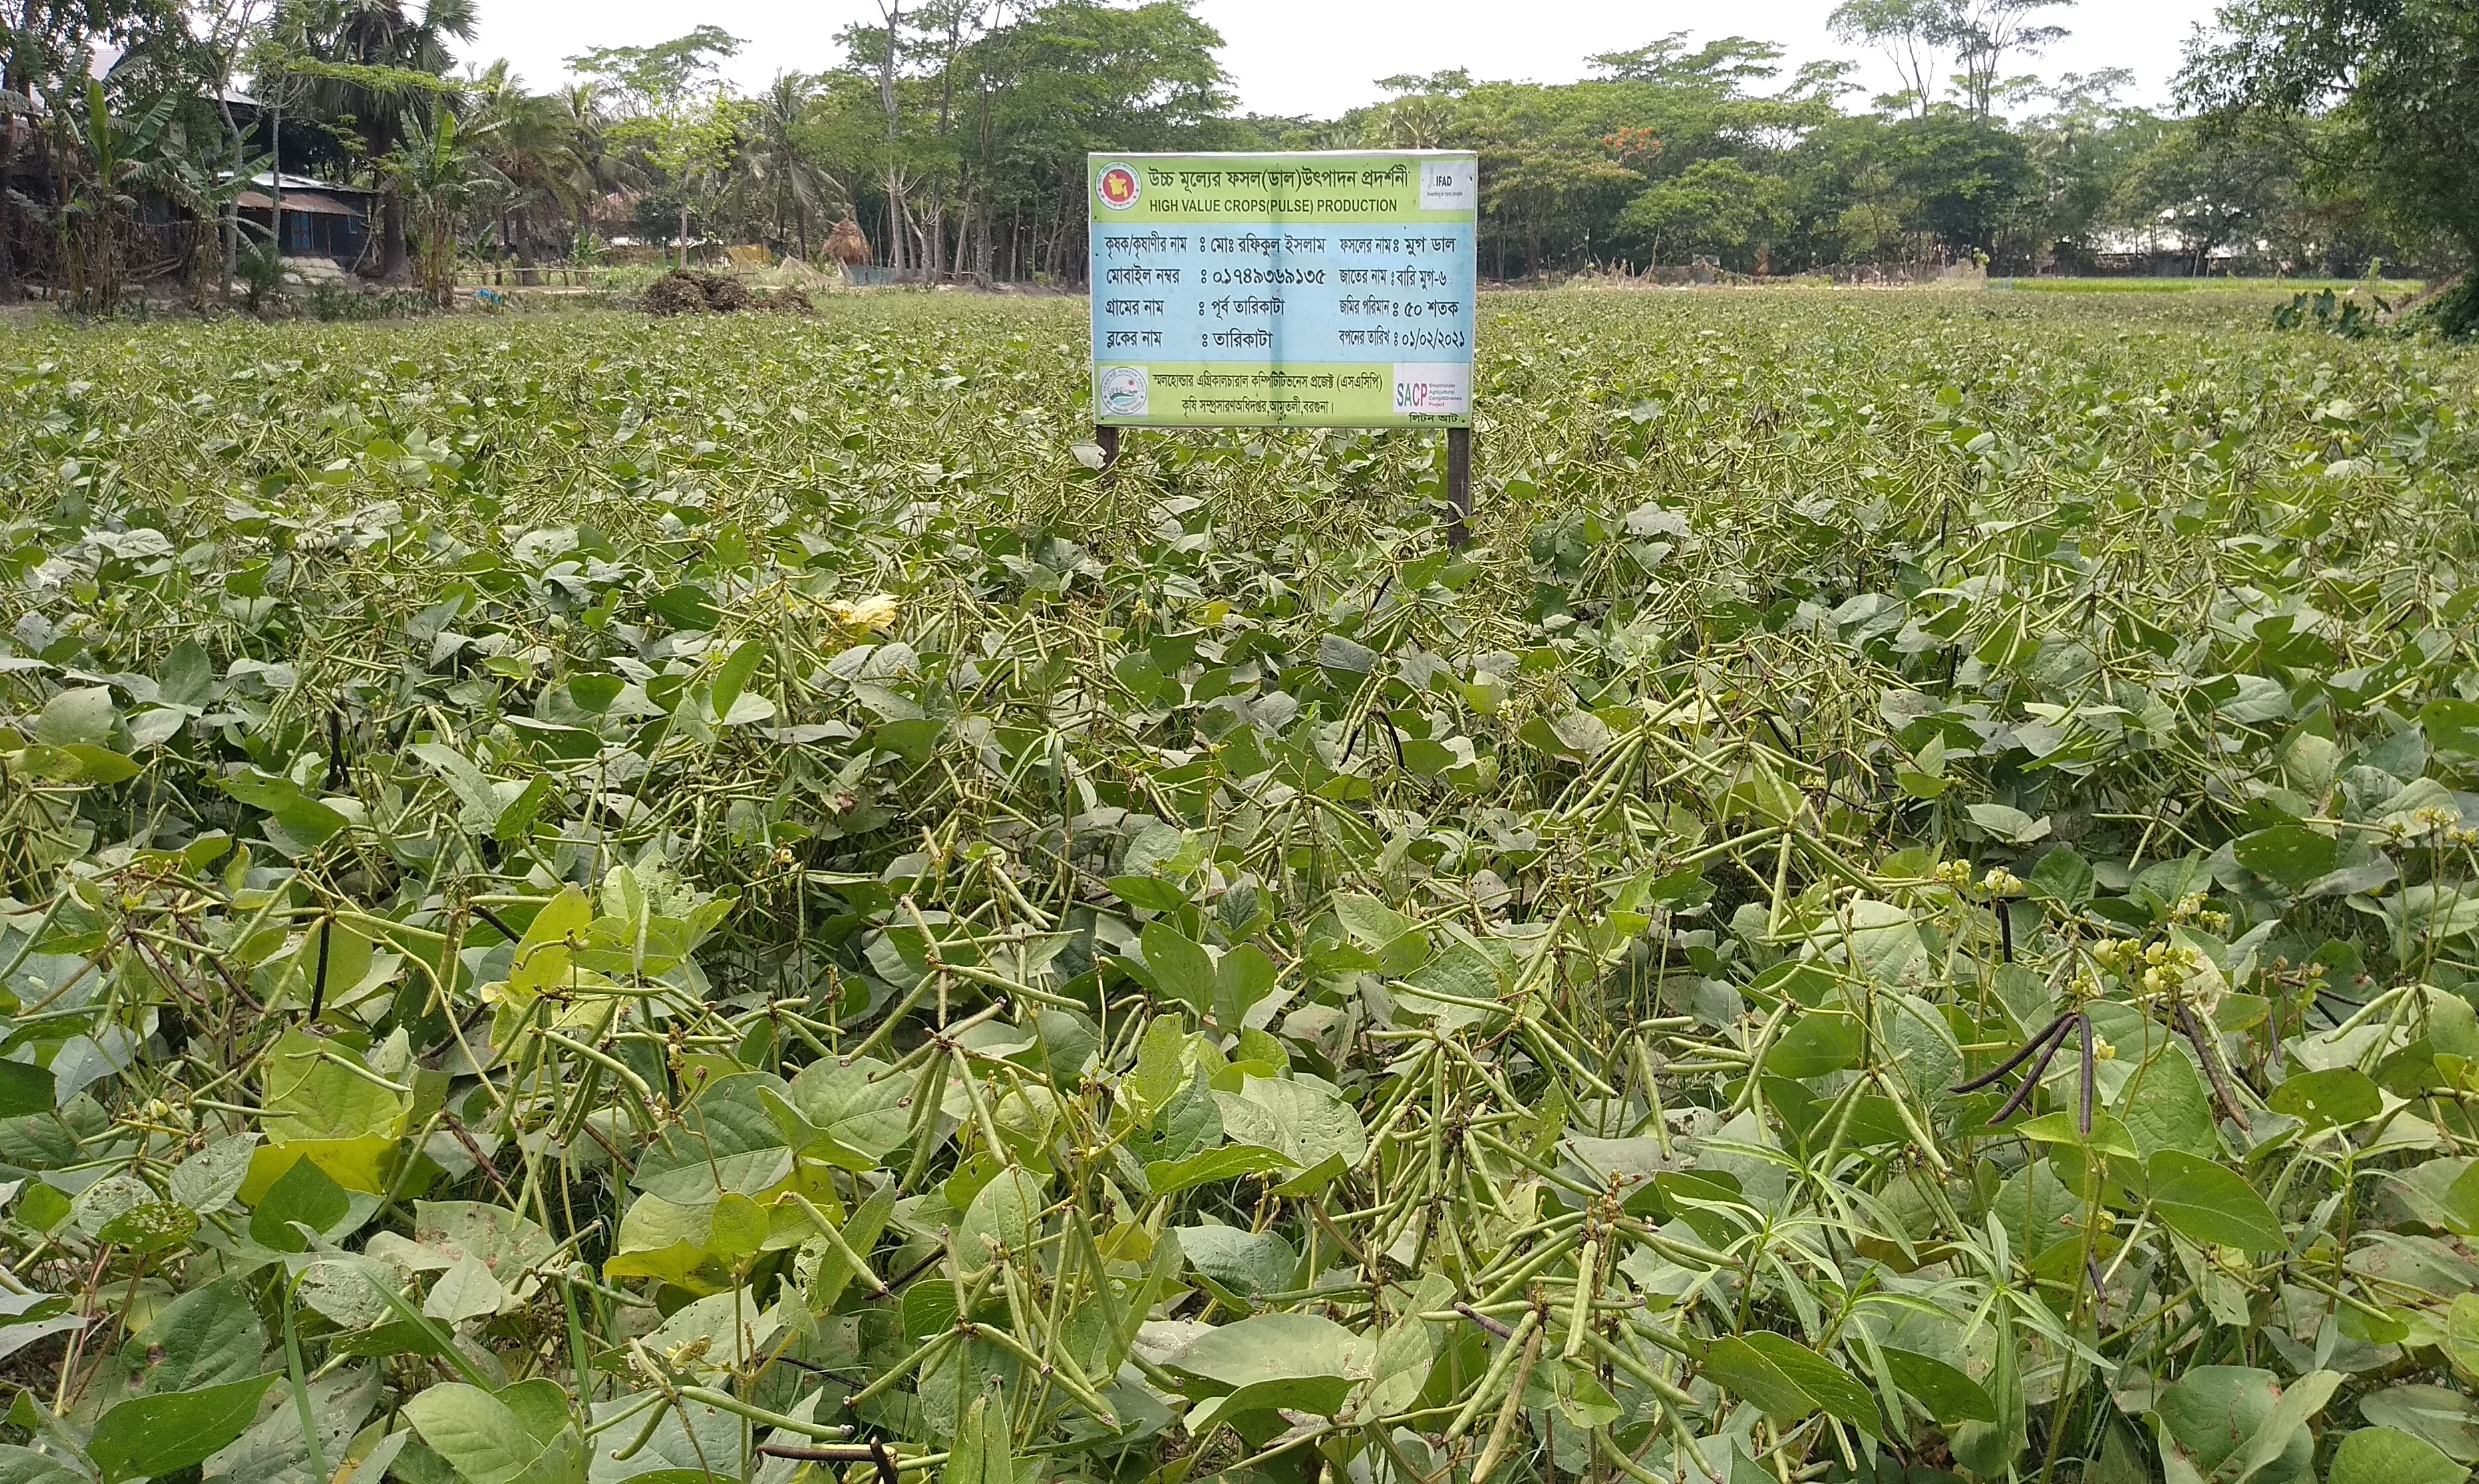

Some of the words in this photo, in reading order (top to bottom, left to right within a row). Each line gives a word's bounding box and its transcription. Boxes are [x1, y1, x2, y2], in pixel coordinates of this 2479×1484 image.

[1148, 166, 1175, 187] উচ্চ
[1178, 171, 1222, 194] মূল্যের
[1361, 164, 1408, 188] প্রদর্শনী
[1436, 176, 1452, 187] IFAD
[1150, 200, 1178, 212] HIGH
[1182, 200, 1220, 212] VALUE
[1224, 200, 1313, 215] CROPS(PULSE)
[1317, 200, 1397, 212] PRODUCTION
[1170, 235, 1187, 253] নাম
[1211, 236, 1234, 253] মোঃ
[1237, 233, 1281, 257] রফিকুল
[1284, 233, 1327, 255] ইসলাম
[1339, 238, 1373, 254] ফসলের
[1404, 237, 1426, 257] মুগ
[1430, 237, 1456, 253] ডাল
[1106, 263, 1152, 287] মোবাইল
[1155, 269, 1181, 285] নম্বর
[1213, 268, 1326, 285] ০১৭৪৯৩৬৯১৩৫
[1339, 267, 1369, 285] জাতের
[1371, 267, 1387, 285] নাম
[1396, 265, 1416, 287] বারি
[1418, 269, 1446, 291] মুগ-৬
[1106, 298, 1140, 317] গ্রামের
[1142, 298, 1165, 317] নাম
[1211, 295, 1231, 320] পূর্ব
[1233, 295, 1285, 315] তারিকাটা
[1339, 294, 1360, 315] জমির
[1363, 294, 1390, 315] পরিমান
[1405, 302, 1422, 317] ৫০
[1426, 299, 1459, 318] শতক
[1106, 331, 1138, 349] ব্লকের
[1141, 329, 1163, 347] নাম
[1212, 327, 1273, 349] তারিকাটা
[1339, 329, 1365, 346] বপনের
[1367, 325, 1390, 346] তারিখ
[1402, 328, 1465, 350] ০১/০২/২০২১
[1337, 372, 1383, 392] (এসএসিপি)
[1181, 395, 1198, 418] কৃষি
[1397, 382, 1428, 407] SACP
[1408, 412, 1435, 423] লিটন
